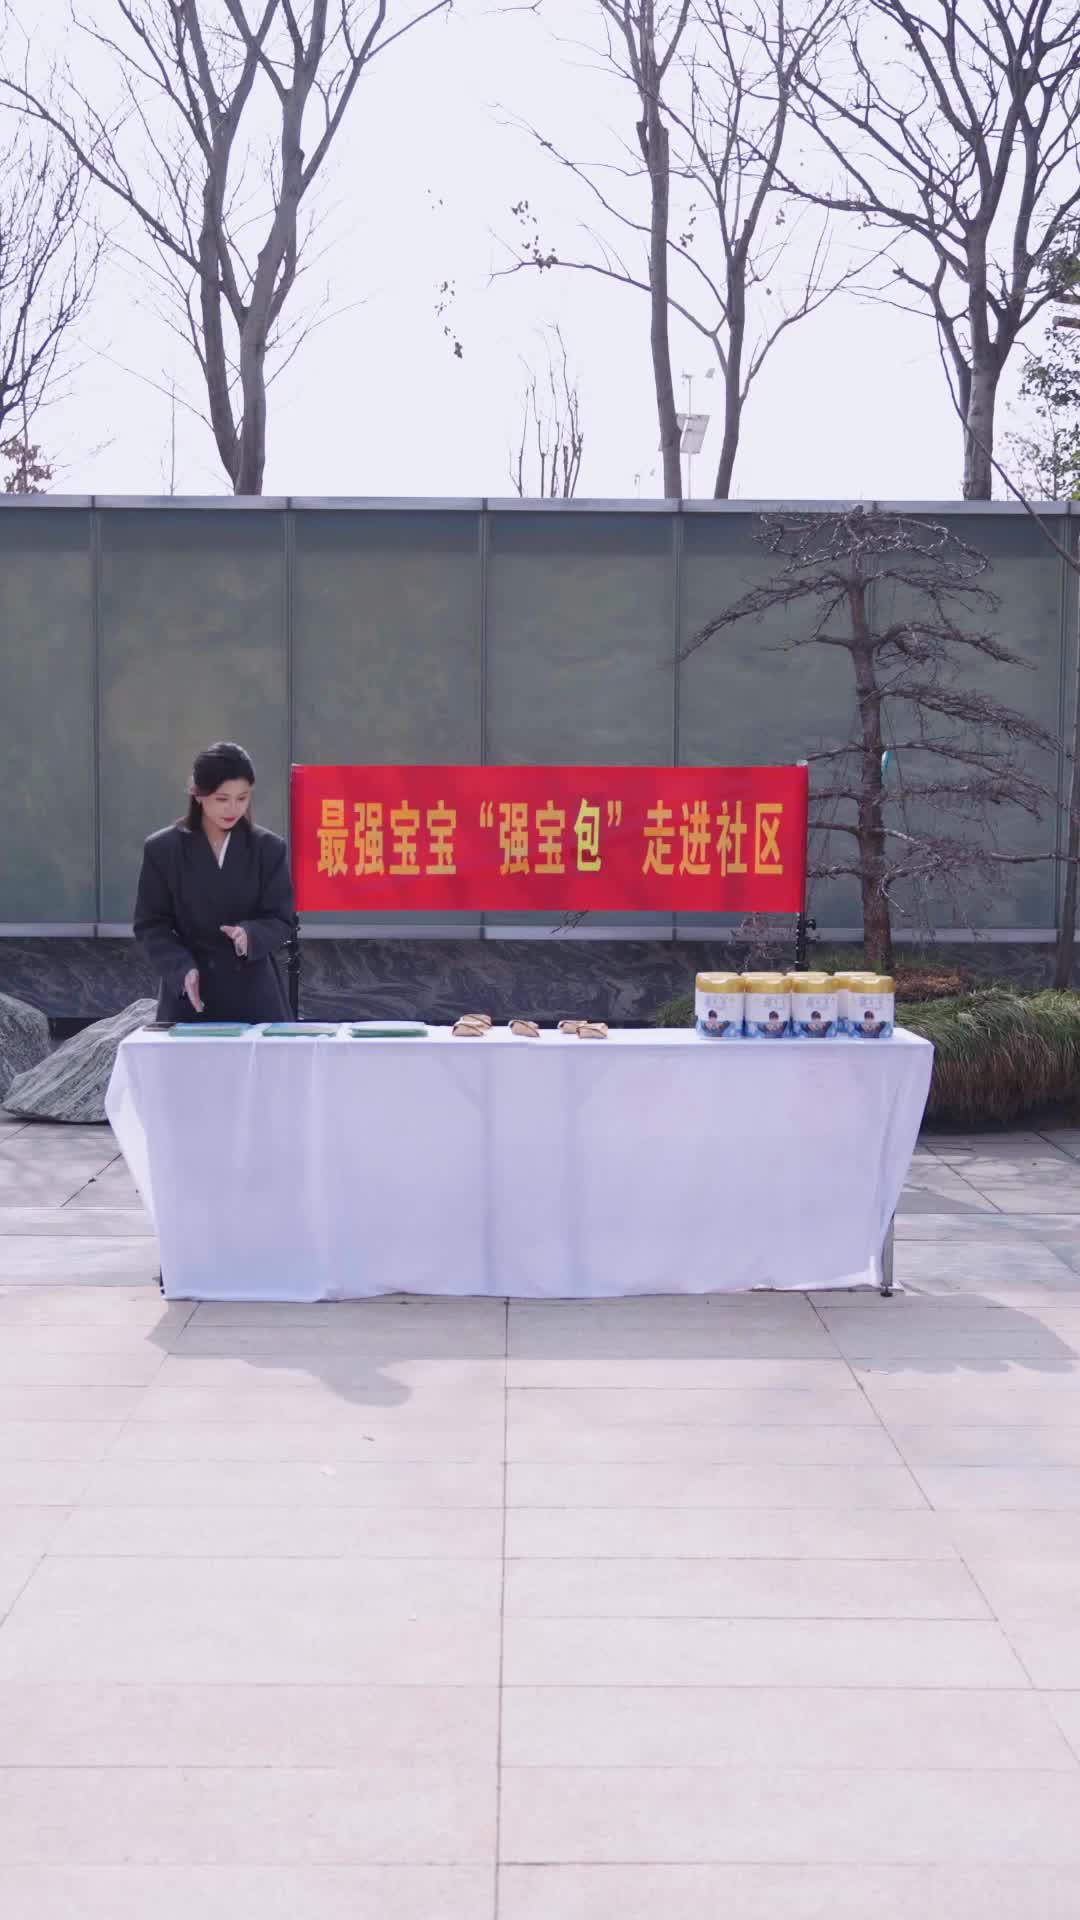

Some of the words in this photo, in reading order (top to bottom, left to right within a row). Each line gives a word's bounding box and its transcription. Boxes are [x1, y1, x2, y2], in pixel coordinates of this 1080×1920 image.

[316, 799, 457, 876] 最强宝宝
[642, 799, 784, 876] 走进社区
